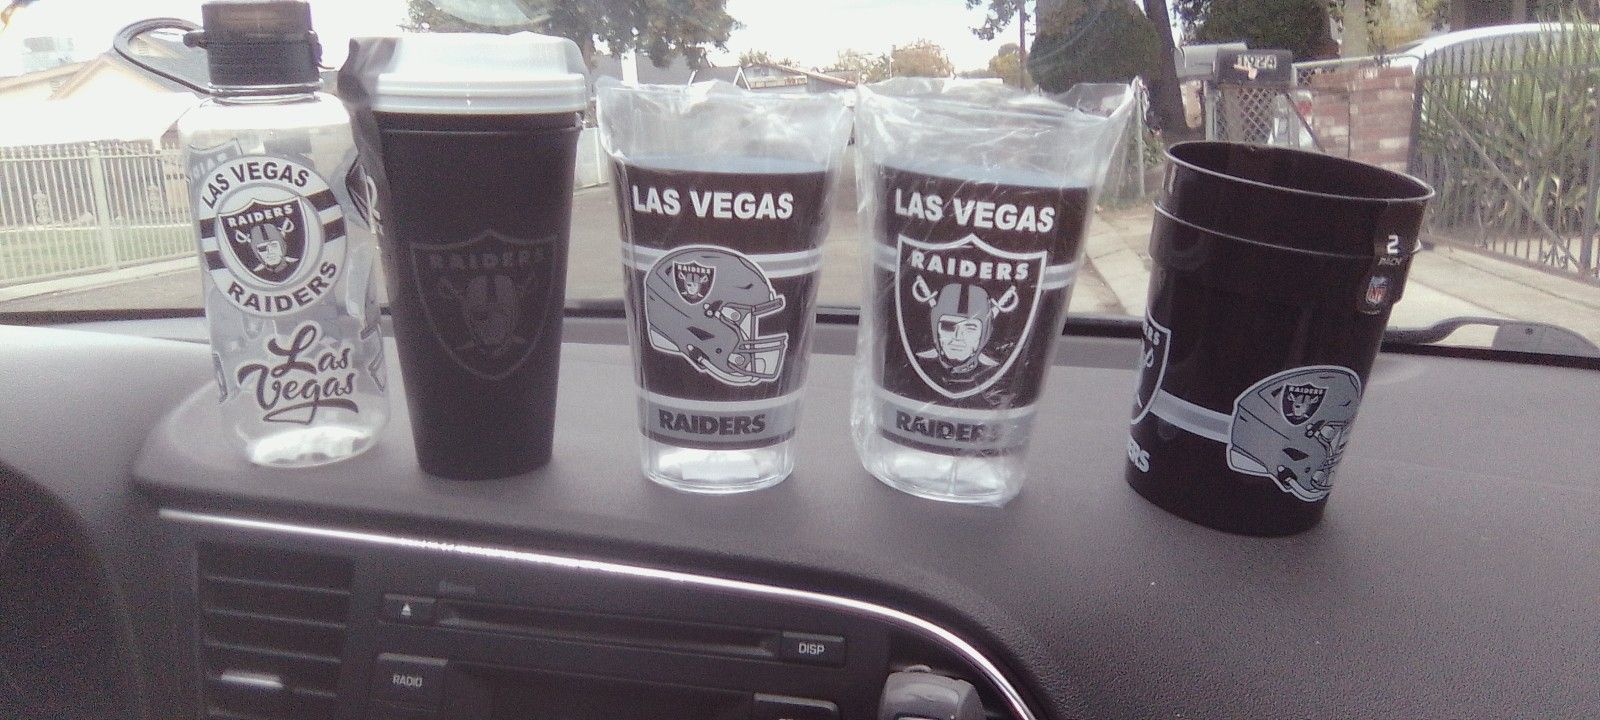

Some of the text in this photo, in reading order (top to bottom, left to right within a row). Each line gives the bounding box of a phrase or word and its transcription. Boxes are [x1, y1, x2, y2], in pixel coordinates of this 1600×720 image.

[202, 174, 230, 209] LAS
[230, 161, 310, 188] VEGAS
[227, 203, 294, 228] RAIDERS
[632, 185, 794, 219] LAS VEGAS
[895, 188, 1056, 233] LAS VEGAS
[1387, 234, 1399, 254] 2
[428, 247, 546, 271] RAIDERS
[677, 262, 712, 274] RAIDERS
[911, 250, 1029, 280] RAIDERS
[227, 261, 337, 313] RAIDERS
[268, 323, 351, 376] Las
[238, 362, 359, 425] Vegas
[1288, 386, 1325, 396] RAIDERS
[658, 408, 766, 435] RAIDERS
[895, 409, 999, 442] RAIDER
[798, 642, 825, 655] DISP
[392, 674, 423, 688] RADIO
